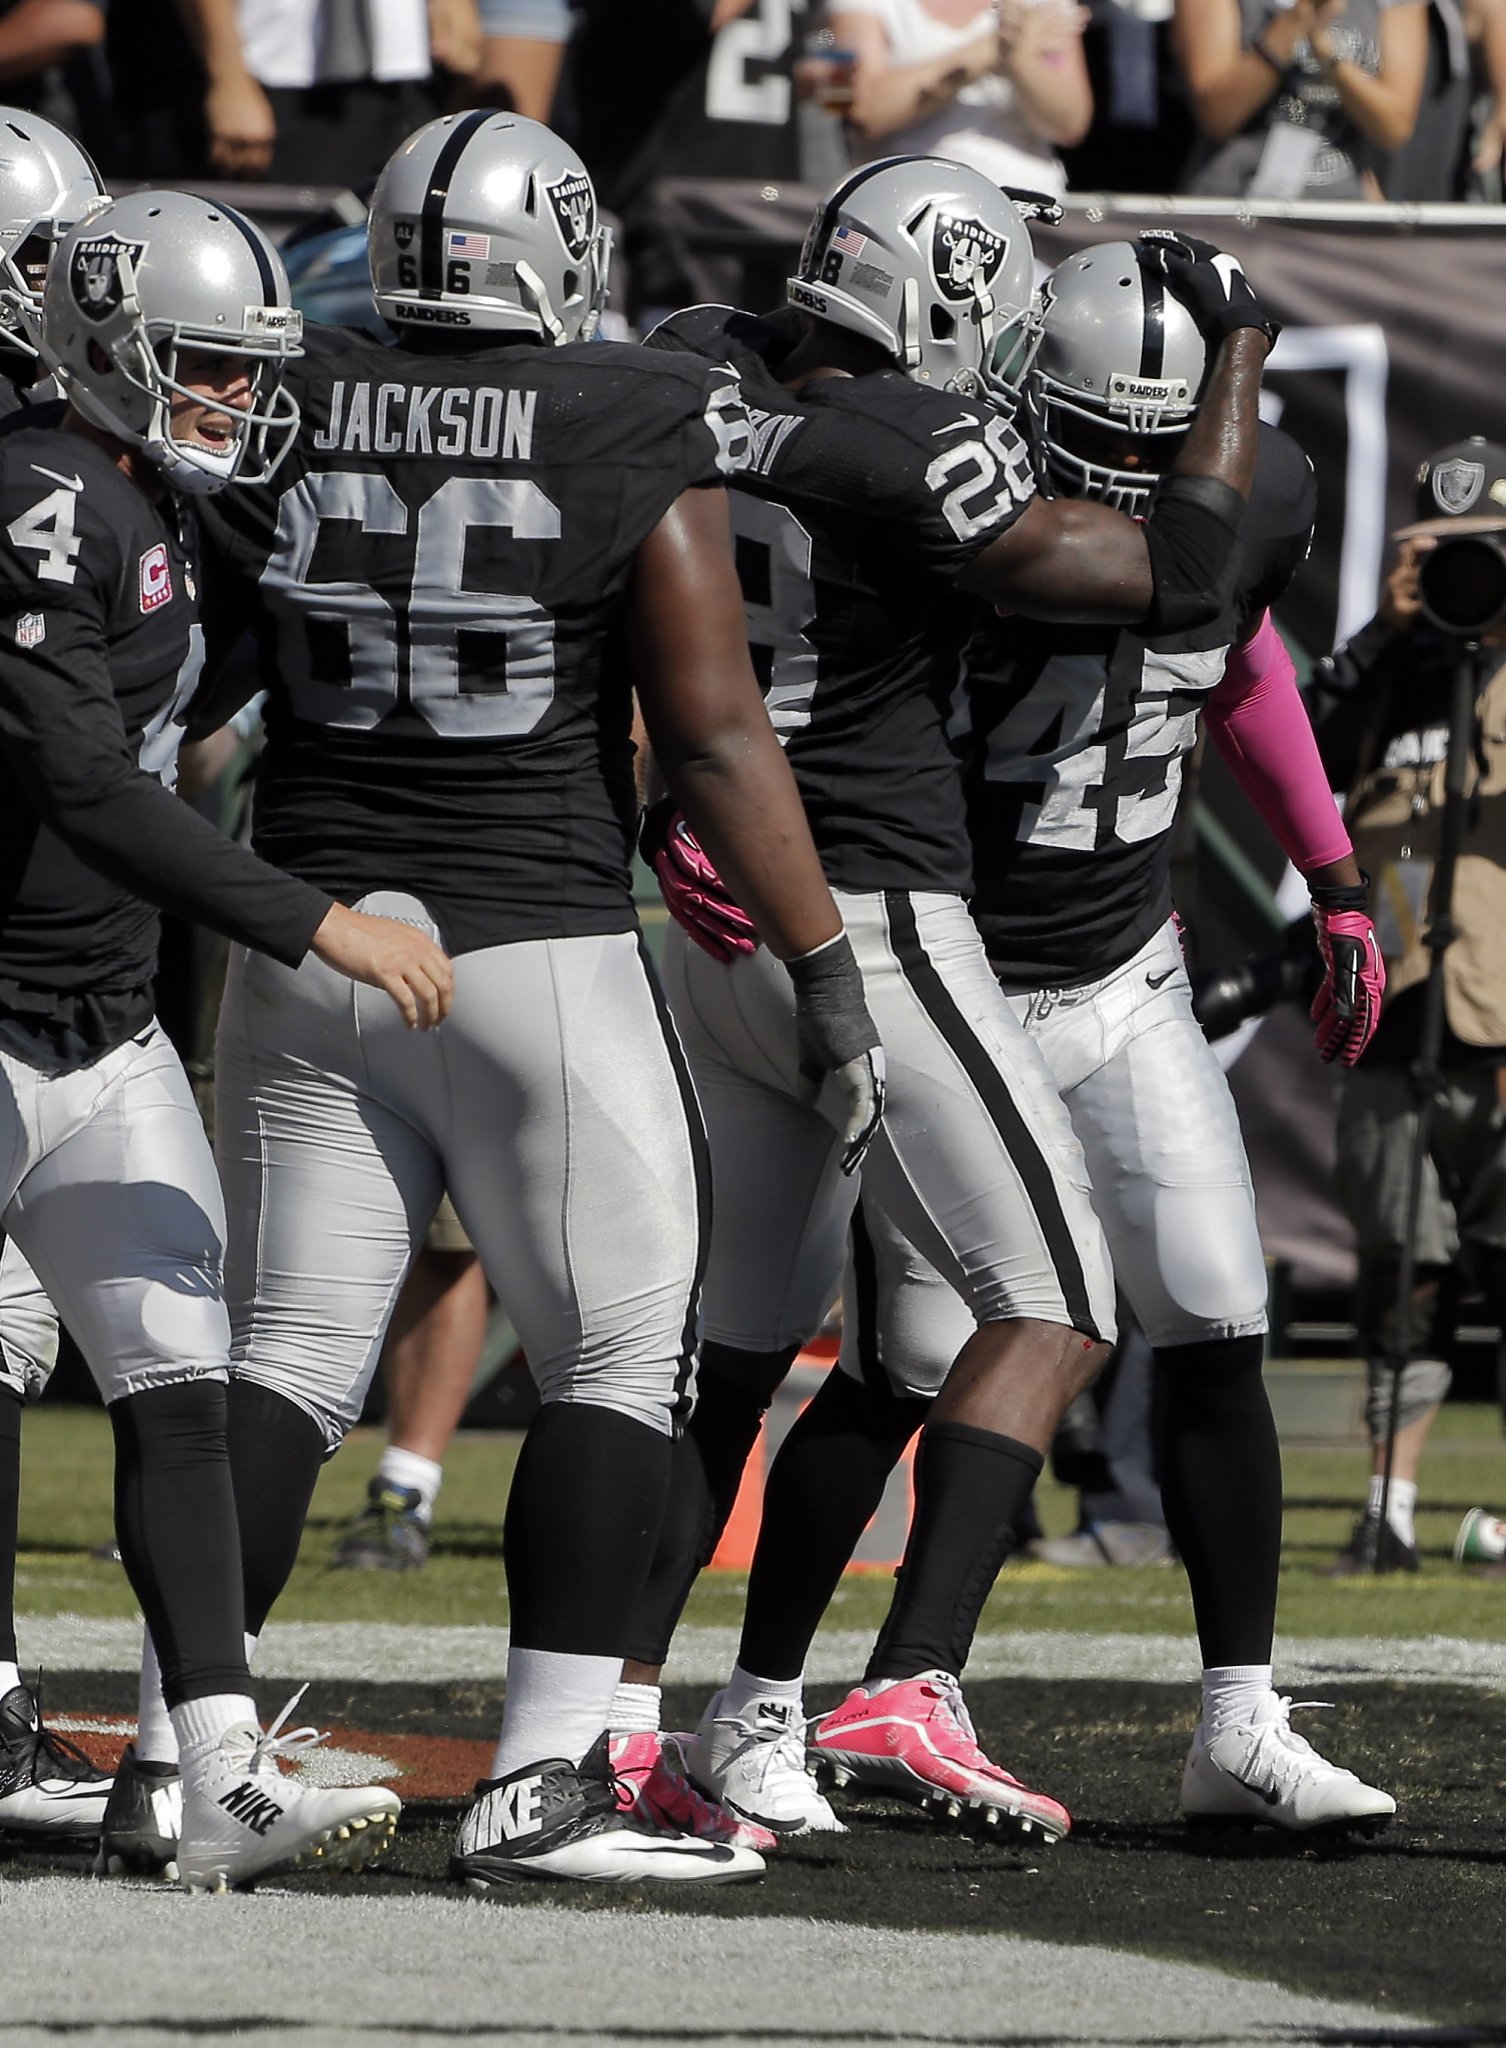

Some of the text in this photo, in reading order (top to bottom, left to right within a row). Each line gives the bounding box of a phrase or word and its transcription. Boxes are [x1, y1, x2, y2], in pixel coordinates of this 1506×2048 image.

[80, 242, 136, 256] RAIDERS
[941, 214, 1001, 249] RAIDERS
[395, 304, 471, 325] RAIDERS
[1129, 383, 1169, 397] RAIDERS
[314, 377, 538, 460] JACKSON
[924, 414, 1037, 543] 28
[6, 488, 82, 584] 4
[142, 548, 167, 597] C
[259, 471, 561, 737] 66
[19, 626, 42, 643] NFL
[984, 644, 1231, 852] 45
[218, 1780, 285, 1837] NIKE
